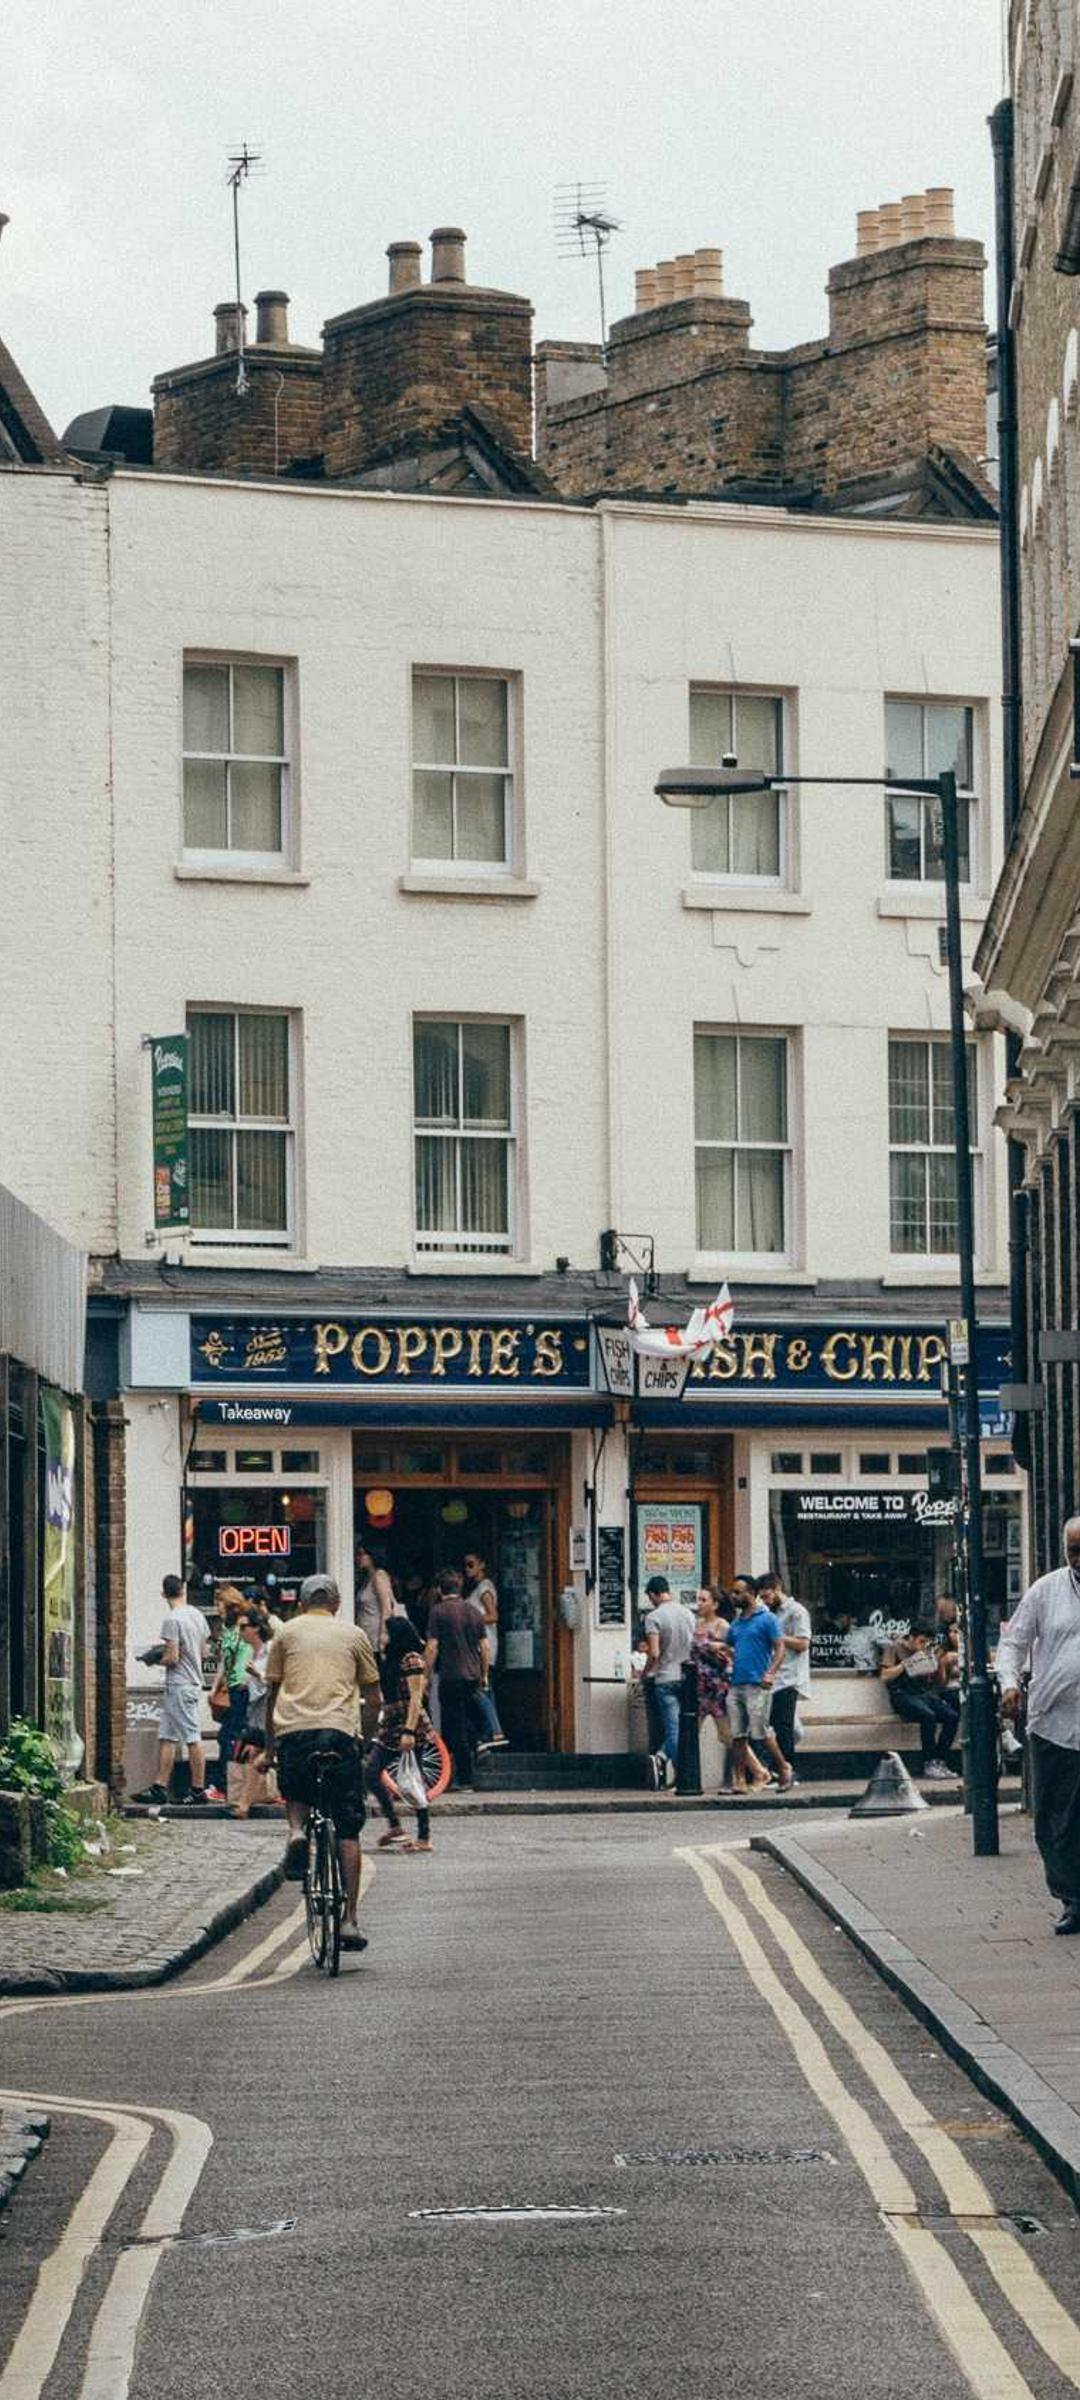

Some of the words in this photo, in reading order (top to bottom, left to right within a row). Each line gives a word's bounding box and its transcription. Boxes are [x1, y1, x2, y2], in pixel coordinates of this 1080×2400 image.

[244, 1346, 287, 1369] 1952
[313, 1323, 564, 1377] POPPIE'S
[605, 1338, 630, 1358] FISH
[787, 1338, 811, 1371] &
[644, 1371, 678, 1389] CHIPS
[218, 1402, 292, 1424] Takeaway
[800, 1496, 880, 1510] WELCOME
[883, 1496, 905, 1510] TO
[797, 1512, 851, 1520] RESTAURANT
[862, 1512, 883, 1520] TAKE
[884, 1512, 907, 1520] AWAY
[222, 1528, 287, 1553] OPEN
